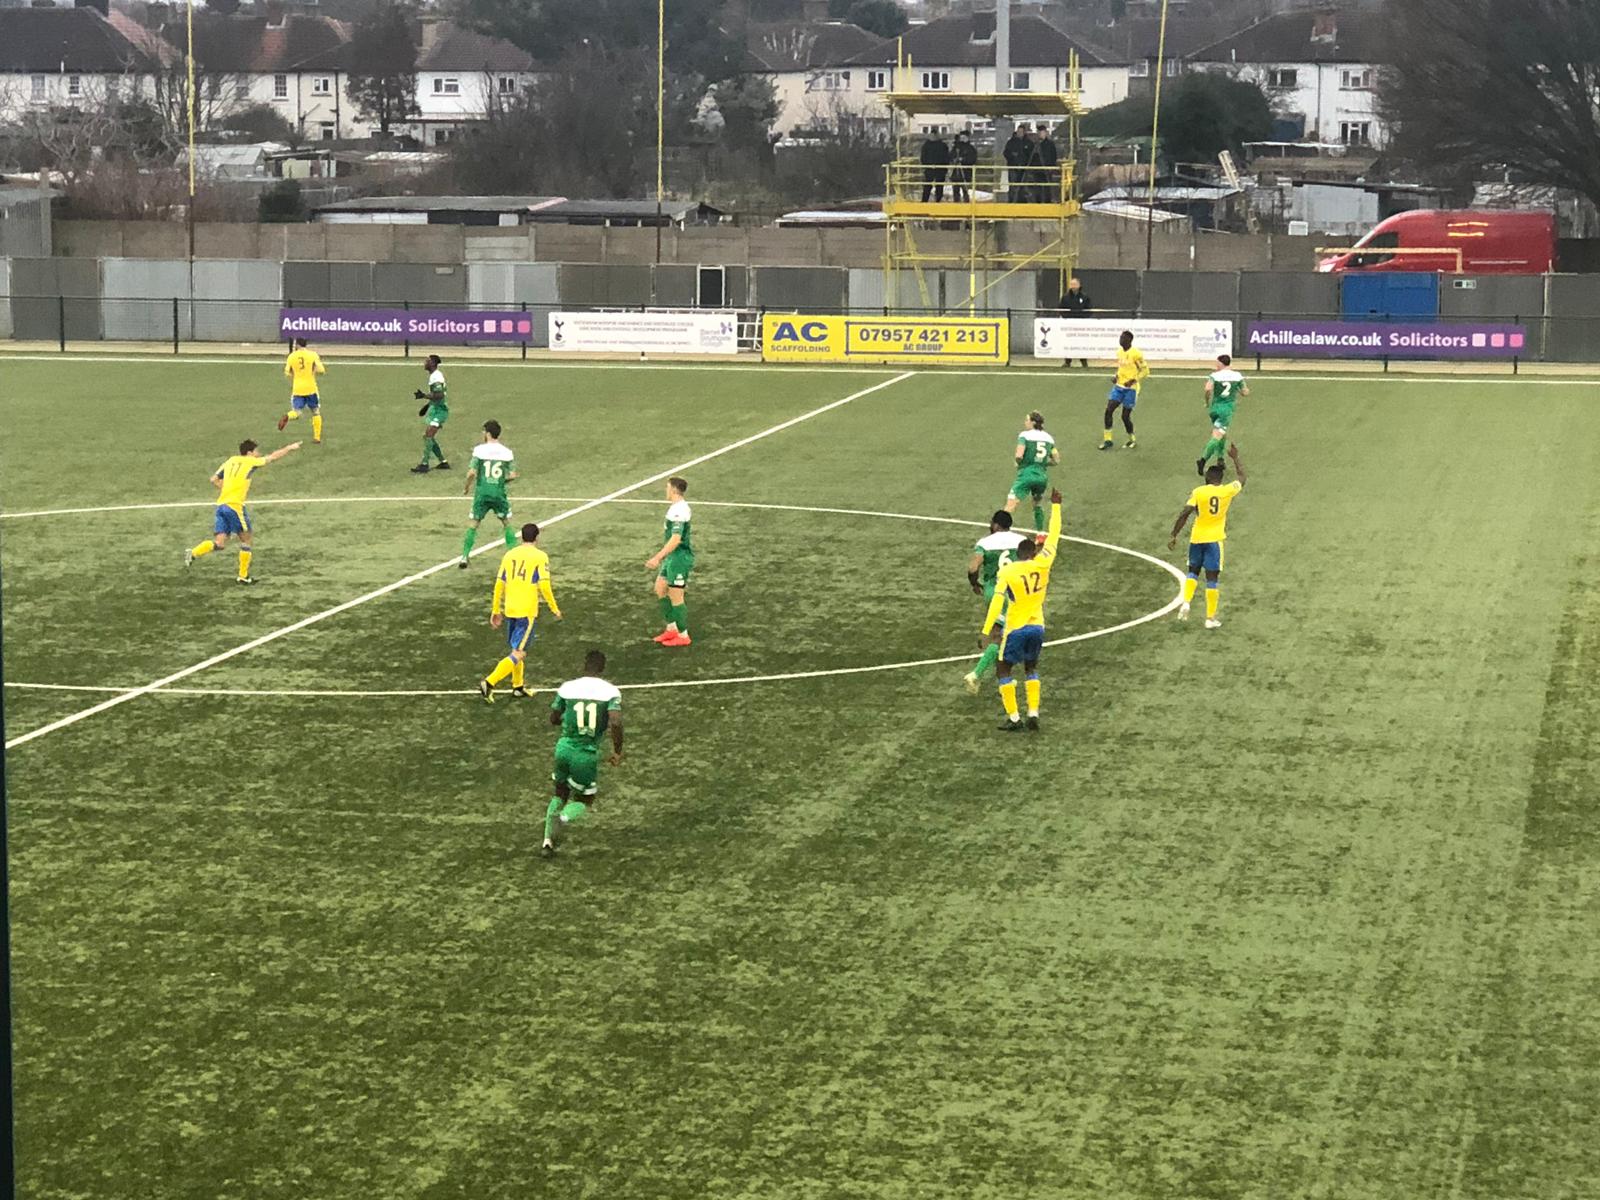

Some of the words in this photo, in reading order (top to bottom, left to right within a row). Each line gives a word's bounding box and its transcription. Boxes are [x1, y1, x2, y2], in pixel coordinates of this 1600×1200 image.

[282, 317, 402, 333] Achillealaw.co.uk
[408, 319, 480, 333] Solicitors
[772, 321, 828, 342] AC
[859, 328, 914, 342] 07957
[919, 329, 949, 343] 421
[956, 330, 989, 343] 213
[1250, 330, 1382, 346] Achillealaw.co.uk
[1389, 333, 1468, 347] Solicitors
[903, 343, 915, 351] AC
[297, 356, 305, 370] 3
[1220, 381, 1232, 398] 2
[1035, 441, 1047, 458] 5
[483, 461, 503, 479] 16
[1209, 496, 1219, 515] 9
[511, 559, 527, 581] 14
[1020, 571, 1042, 595] 12
[573, 701, 597, 730] 11
